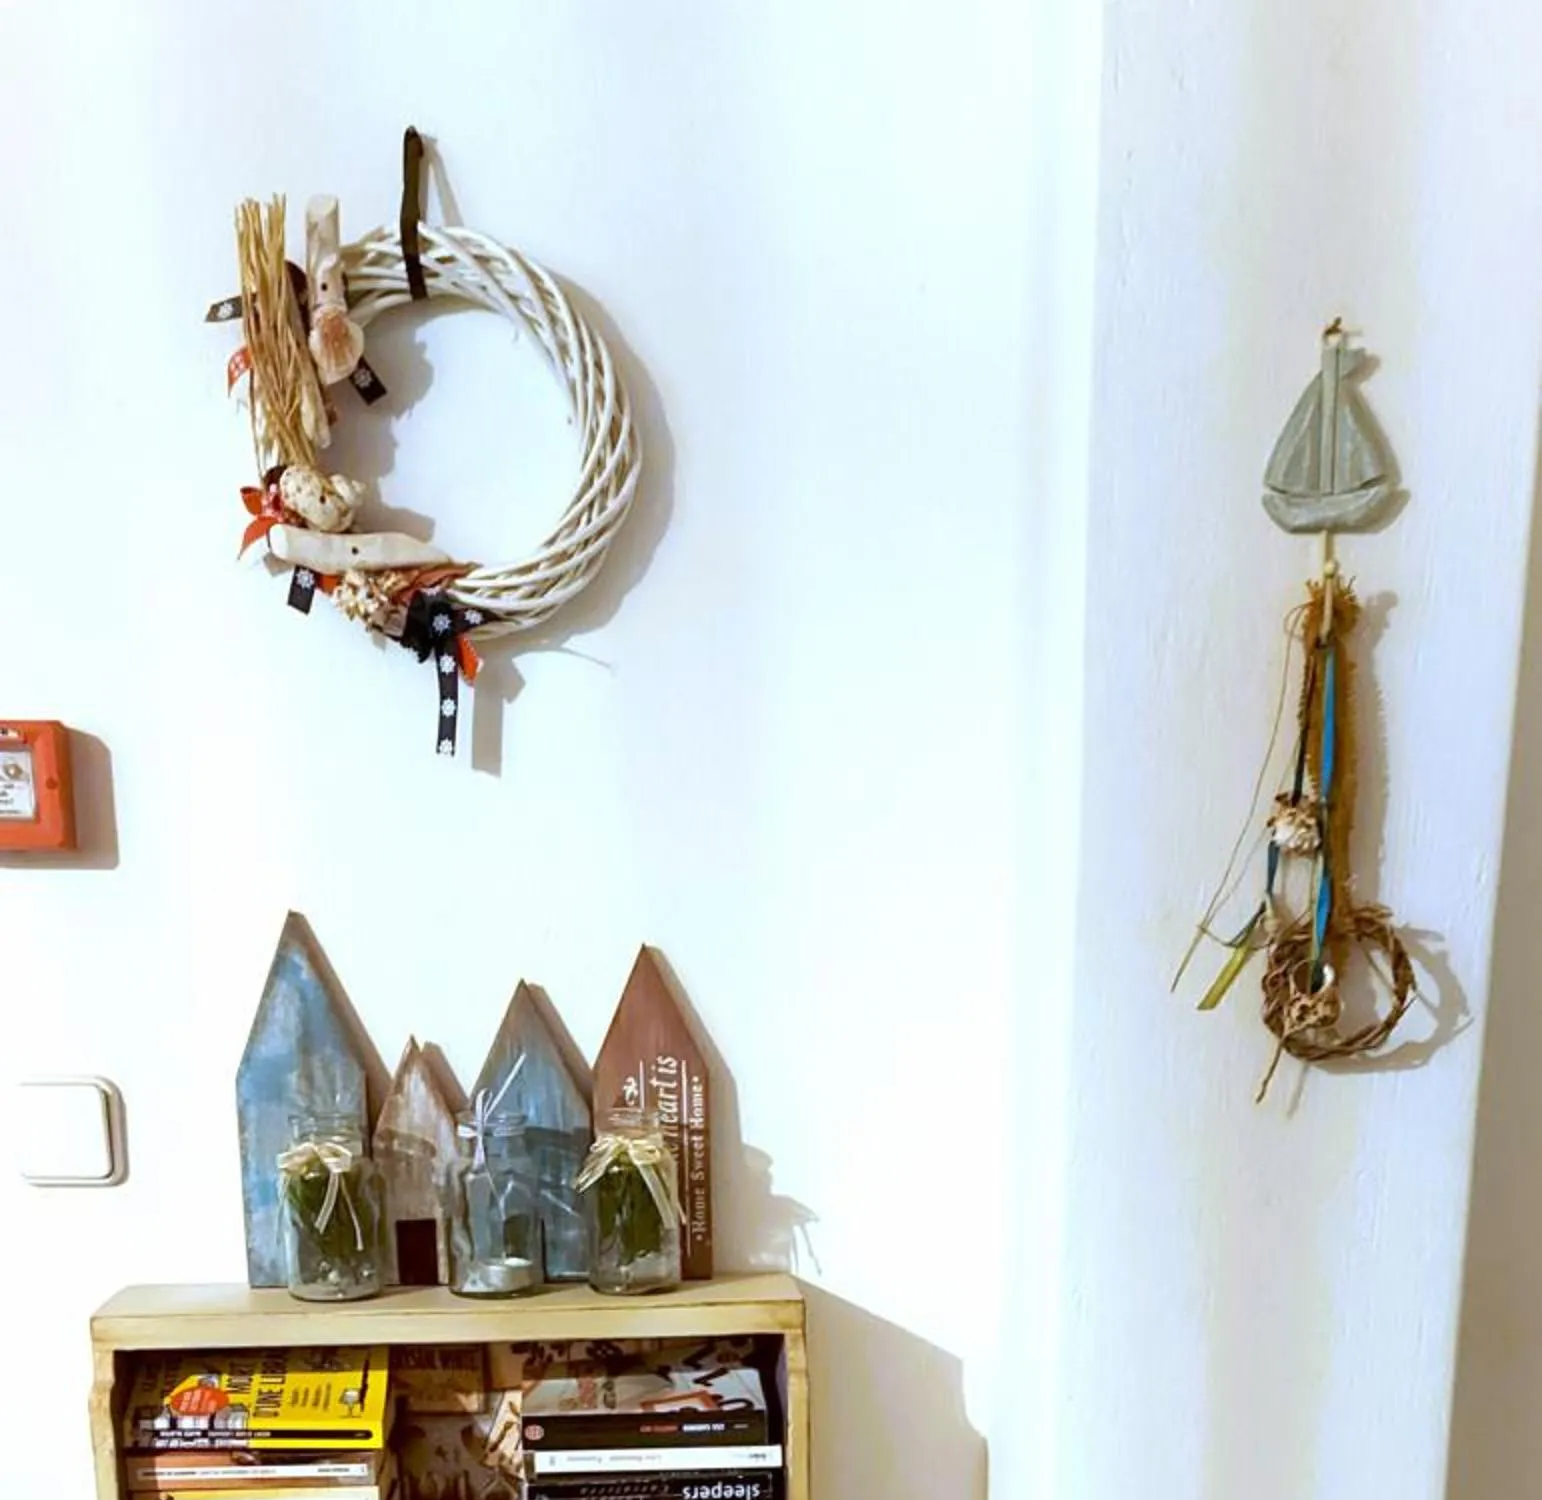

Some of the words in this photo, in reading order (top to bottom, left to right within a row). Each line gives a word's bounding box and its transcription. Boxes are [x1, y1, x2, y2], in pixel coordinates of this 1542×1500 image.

[653, 1056, 679, 1075] is
[690, 1084, 705, 1129] Home
[690, 1136, 705, 1181] Sweet
